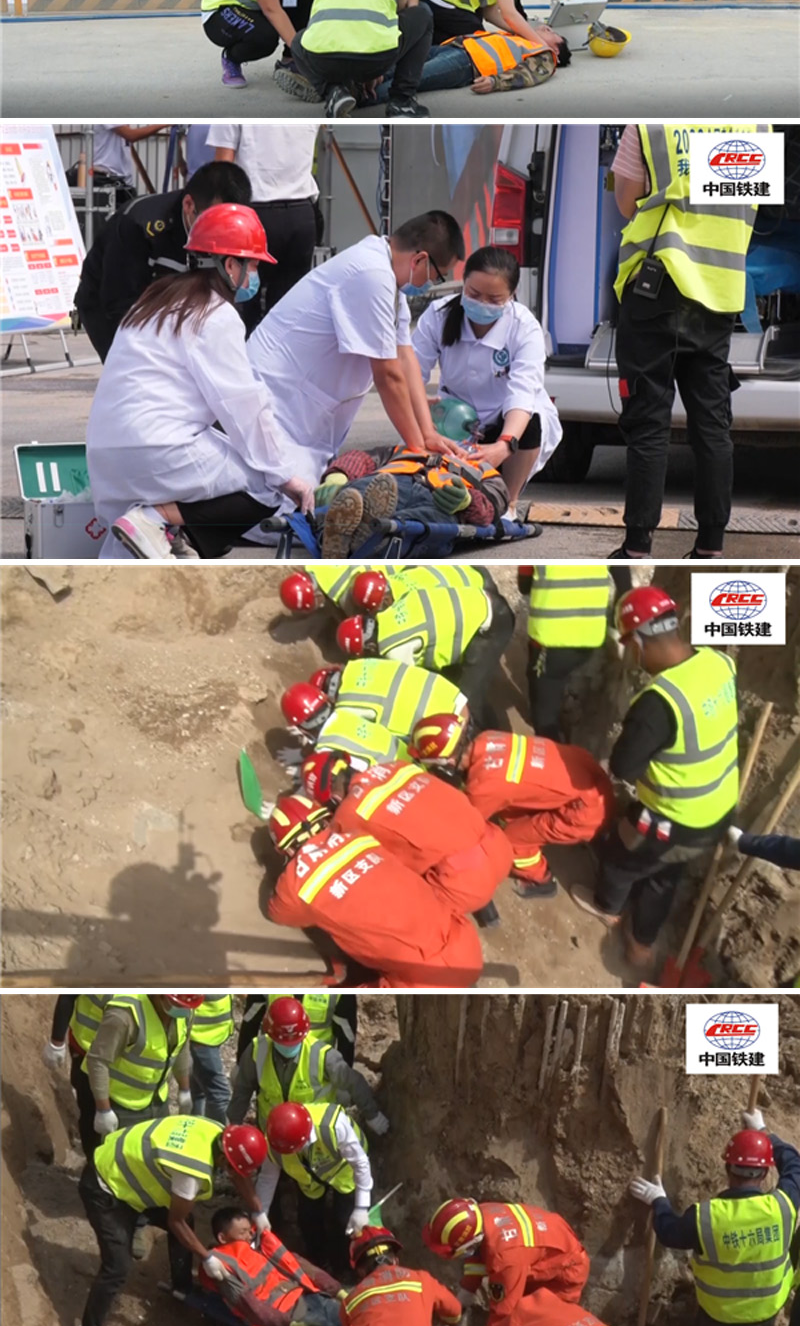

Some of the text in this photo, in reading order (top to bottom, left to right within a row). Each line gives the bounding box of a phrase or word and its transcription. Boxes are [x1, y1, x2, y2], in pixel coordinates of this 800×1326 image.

[220, 7, 255, 34] LAKERS
[329, 852, 384, 900] 新区支队
[722, 1224, 780, 1249] 中铁十六局集团
